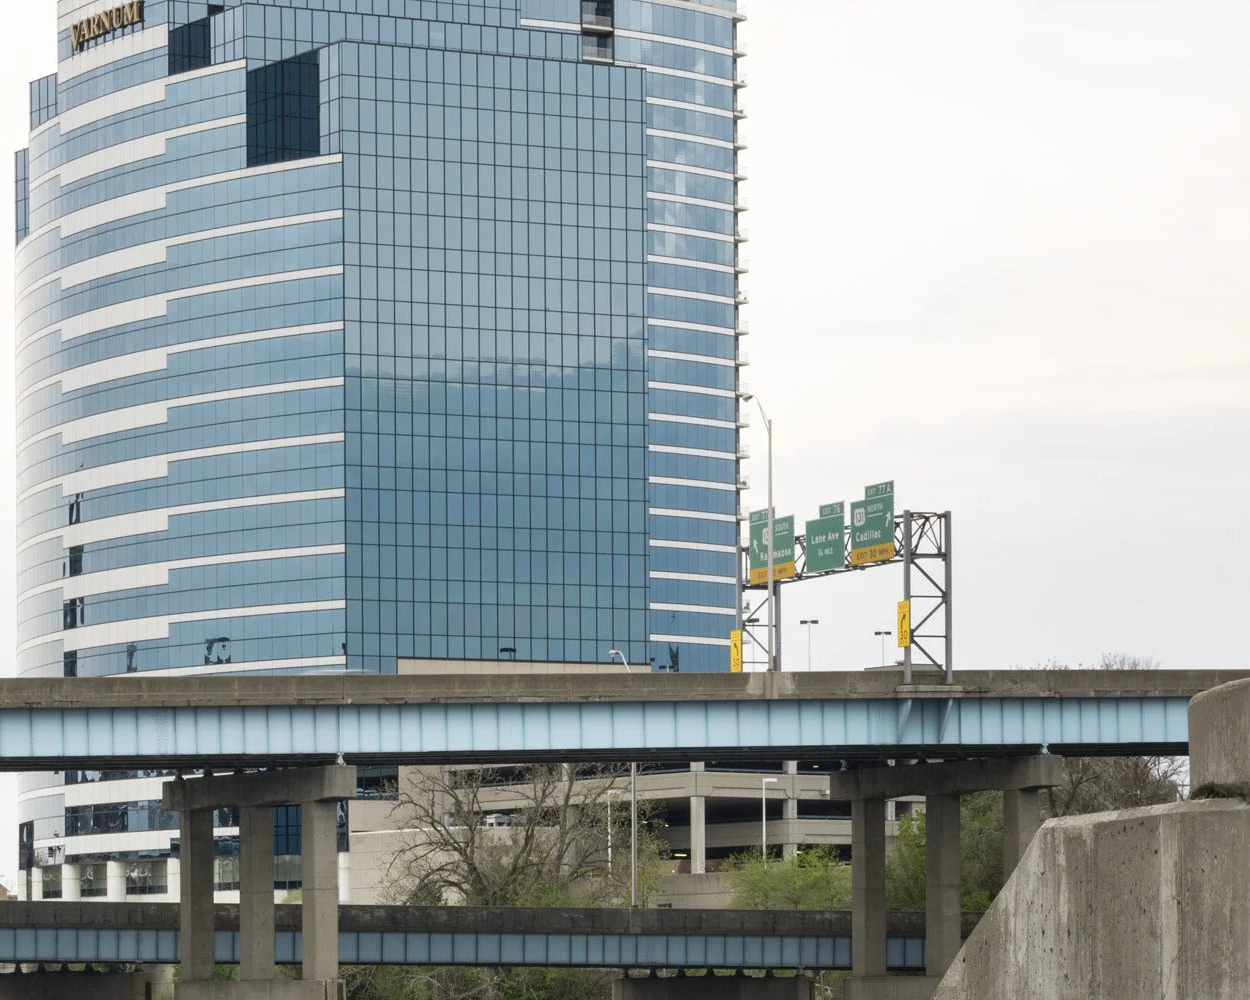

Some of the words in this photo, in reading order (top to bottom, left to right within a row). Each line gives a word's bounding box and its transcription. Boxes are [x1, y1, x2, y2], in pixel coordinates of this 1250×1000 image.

[71, 0, 142, 51] VARNUM
[822, 507, 831, 515] EXIT
[833, 505, 841, 513] 76
[867, 503, 883, 512] NORTH
[855, 511, 865, 524] 131
[774, 522, 789, 532] SOUTH
[811, 534, 826, 545] Lane
[827, 532, 839, 542] Ave
[855, 529, 882, 542] Cadillac
[760, 548, 791, 561] Kamazoo
[856, 552, 868, 560] EXIT
[869, 549, 877, 559] 30
[899, 630, 908, 640] 30
